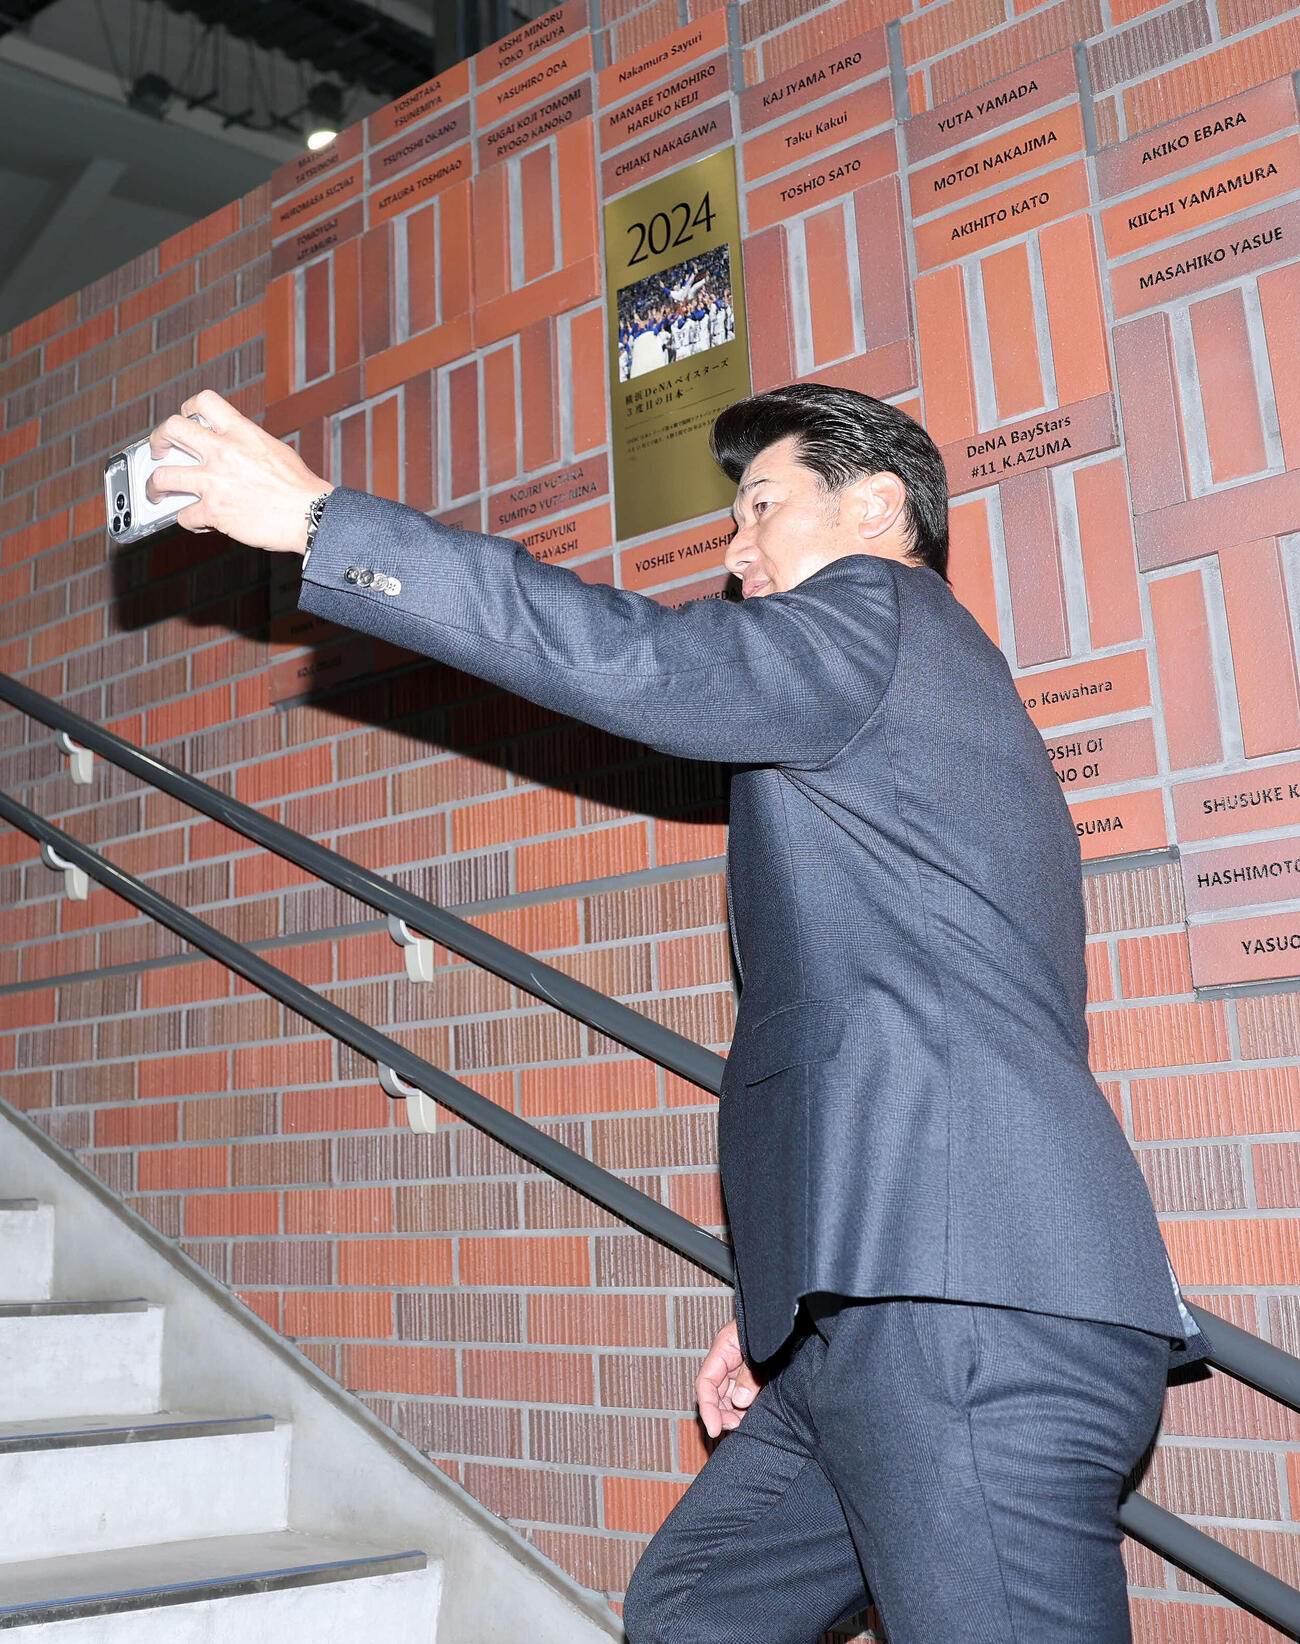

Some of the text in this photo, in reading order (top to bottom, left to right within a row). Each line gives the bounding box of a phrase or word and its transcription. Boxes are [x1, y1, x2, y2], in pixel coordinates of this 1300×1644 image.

[498, 10, 563, 54] KISHI MINORU
[498, 25, 565, 69] YOKO TAKUYA
[618, 31, 703, 83] Nakamura Sayuri
[828, 51, 863, 77] TARO
[497, 60, 567, 104] YASUHIRO ODA
[609, 65, 716, 126] MANABE TOMOHIRO
[487, 88, 582, 146] SUGAI KOJI TOMOMI
[626, 90, 700, 134] HARUKO KEIJI
[937, 79, 1039, 133] YUTA YAMADA
[383, 120, 457, 166] TSUYOSHI OKANO
[496, 110, 573, 157] RYOGO KANOKO
[615, 120, 718, 177] CHIAKI NAKAGAWA
[785, 112, 848, 148] Taku Kakui
[1141, 111, 1247, 165] AKIKO EBARA
[779, 159, 863, 203] TOSHIO SATO
[933, 130, 1058, 192] MOTOI NAKAJIMA
[378, 159, 463, 210] KITAURA TOSHINAO
[1127, 163, 1279, 231] KIICHI YAMAMURA
[626, 191, 717, 267] 2024
[950, 191, 1051, 241] AKIHITO KATO
[1138, 226, 1285, 290] MASAHIKO YASUE
[967, 416, 1072, 459] DeNA BayStars
[499, 503, 537, 526] SUMIYO
[510, 482, 541, 503] NOJIRI
[521, 521, 577, 548] MITSUYUKI
[531, 539, 579, 562] BAYASHI
[635, 551, 675, 573] YOSHIE
[1041, 680, 1113, 706] Kawahara
[1086, 737, 1104, 754] OI
[1082, 763, 1100, 779] OI
[1202, 786, 1283, 815] SHUSUKE
[1076, 816, 1124, 837] SUMA
